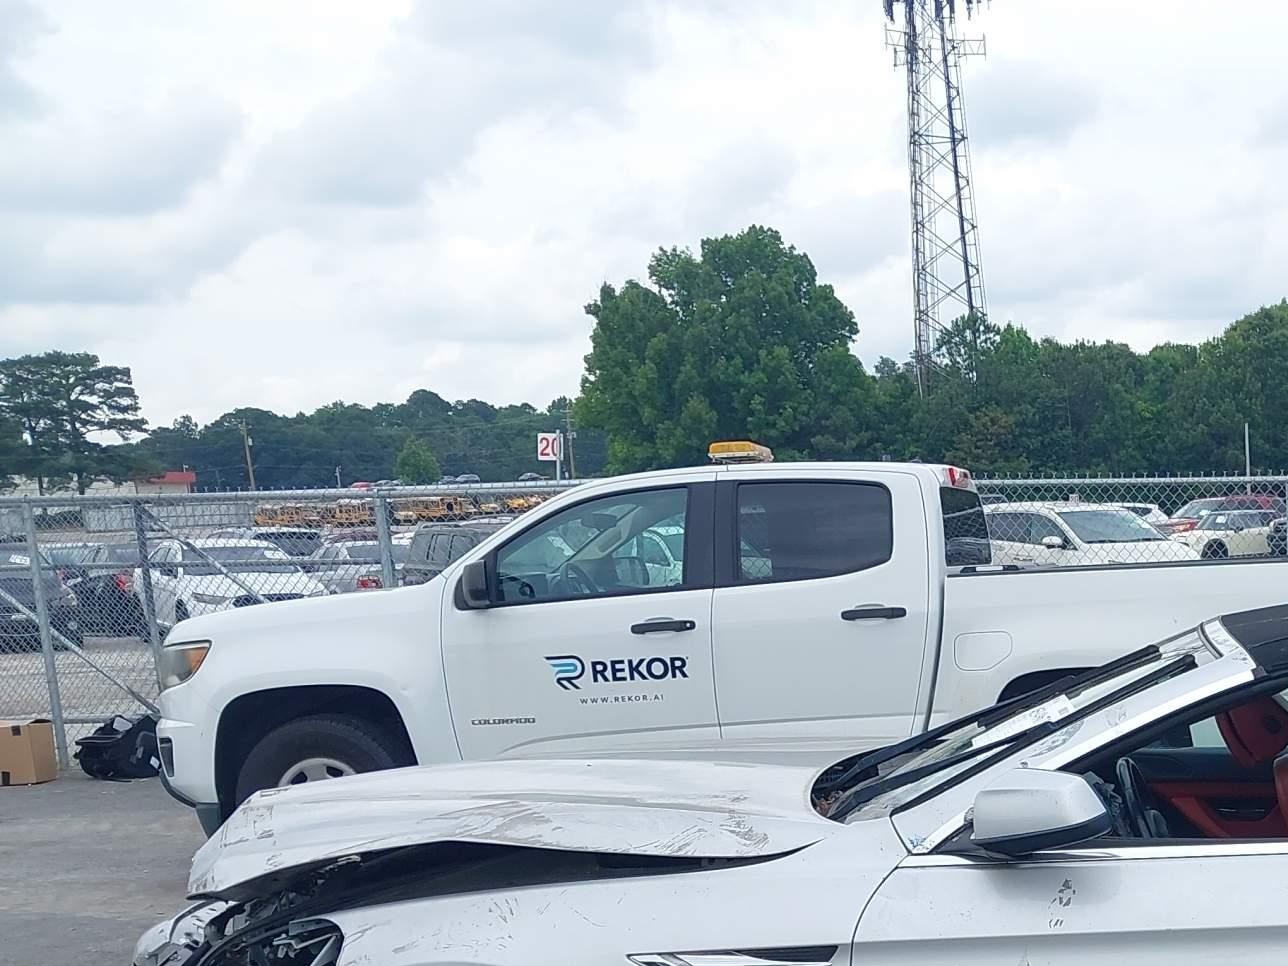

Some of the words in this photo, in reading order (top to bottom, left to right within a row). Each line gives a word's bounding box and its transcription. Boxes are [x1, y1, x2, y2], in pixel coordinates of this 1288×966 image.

[591, 656, 689, 683] REKOR
[580, 694, 664, 705] WWW.REKOR.AI
[471, 717, 536, 726] COLORADO
